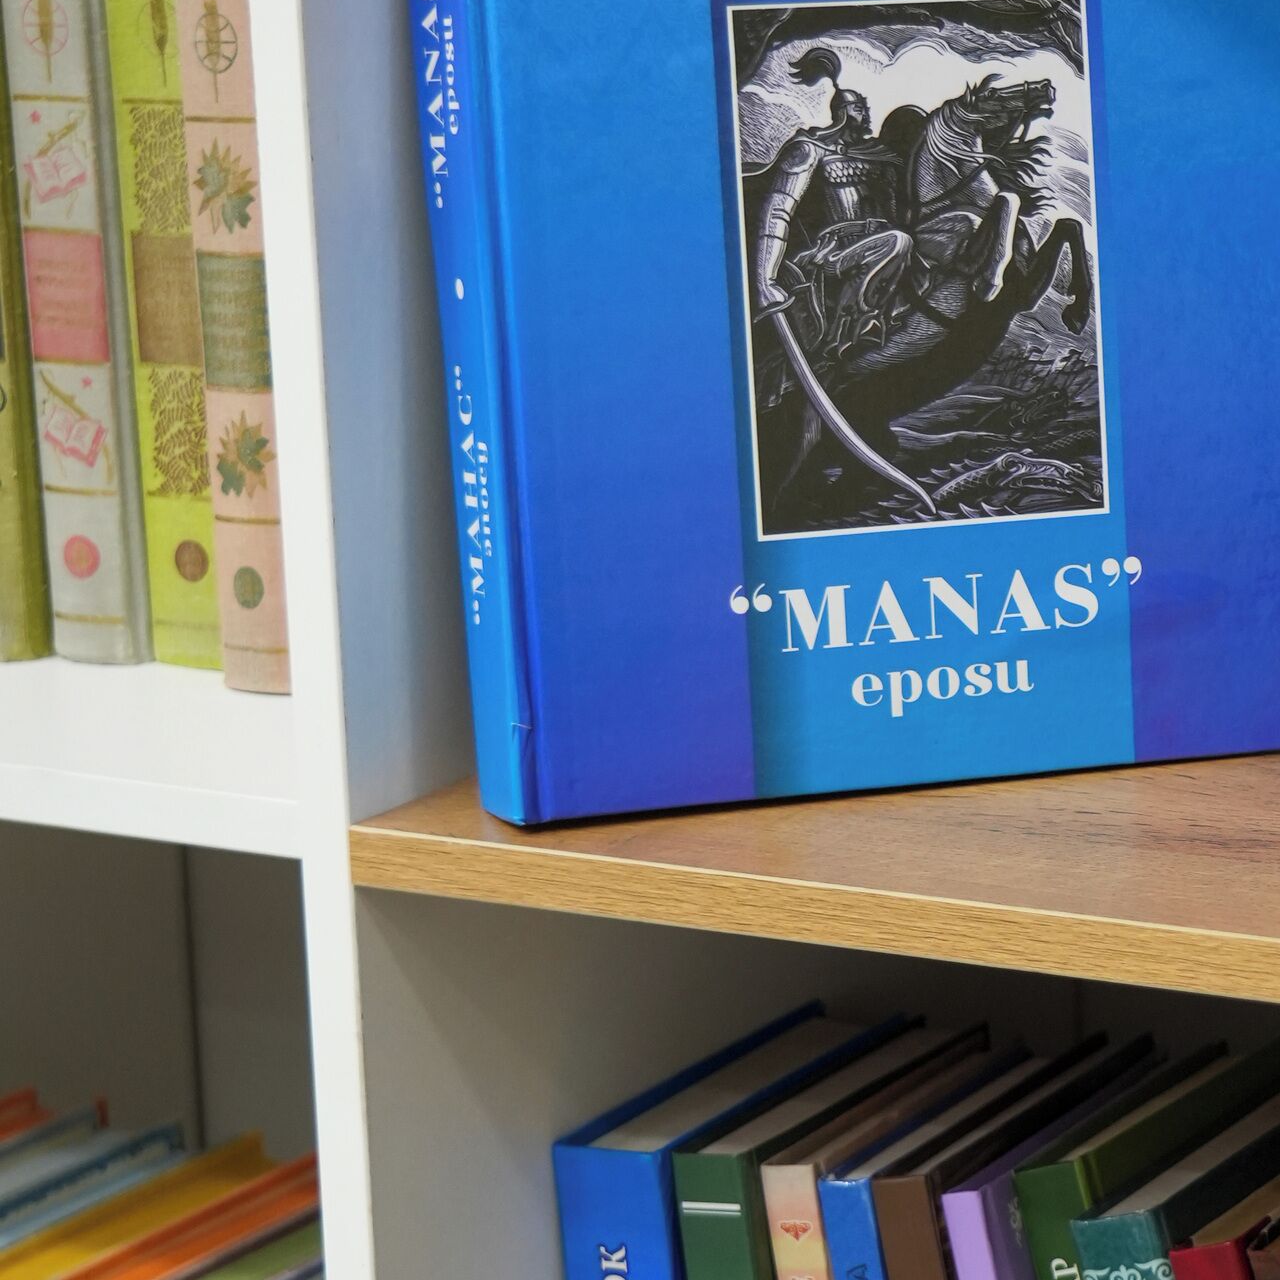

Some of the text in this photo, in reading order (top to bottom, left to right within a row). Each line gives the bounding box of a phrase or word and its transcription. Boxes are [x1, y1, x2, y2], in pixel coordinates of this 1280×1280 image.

[441, 15, 460, 137] eposu
[477, 441, 493, 556] эпосу
[851, 659, 1035, 719] eposu
